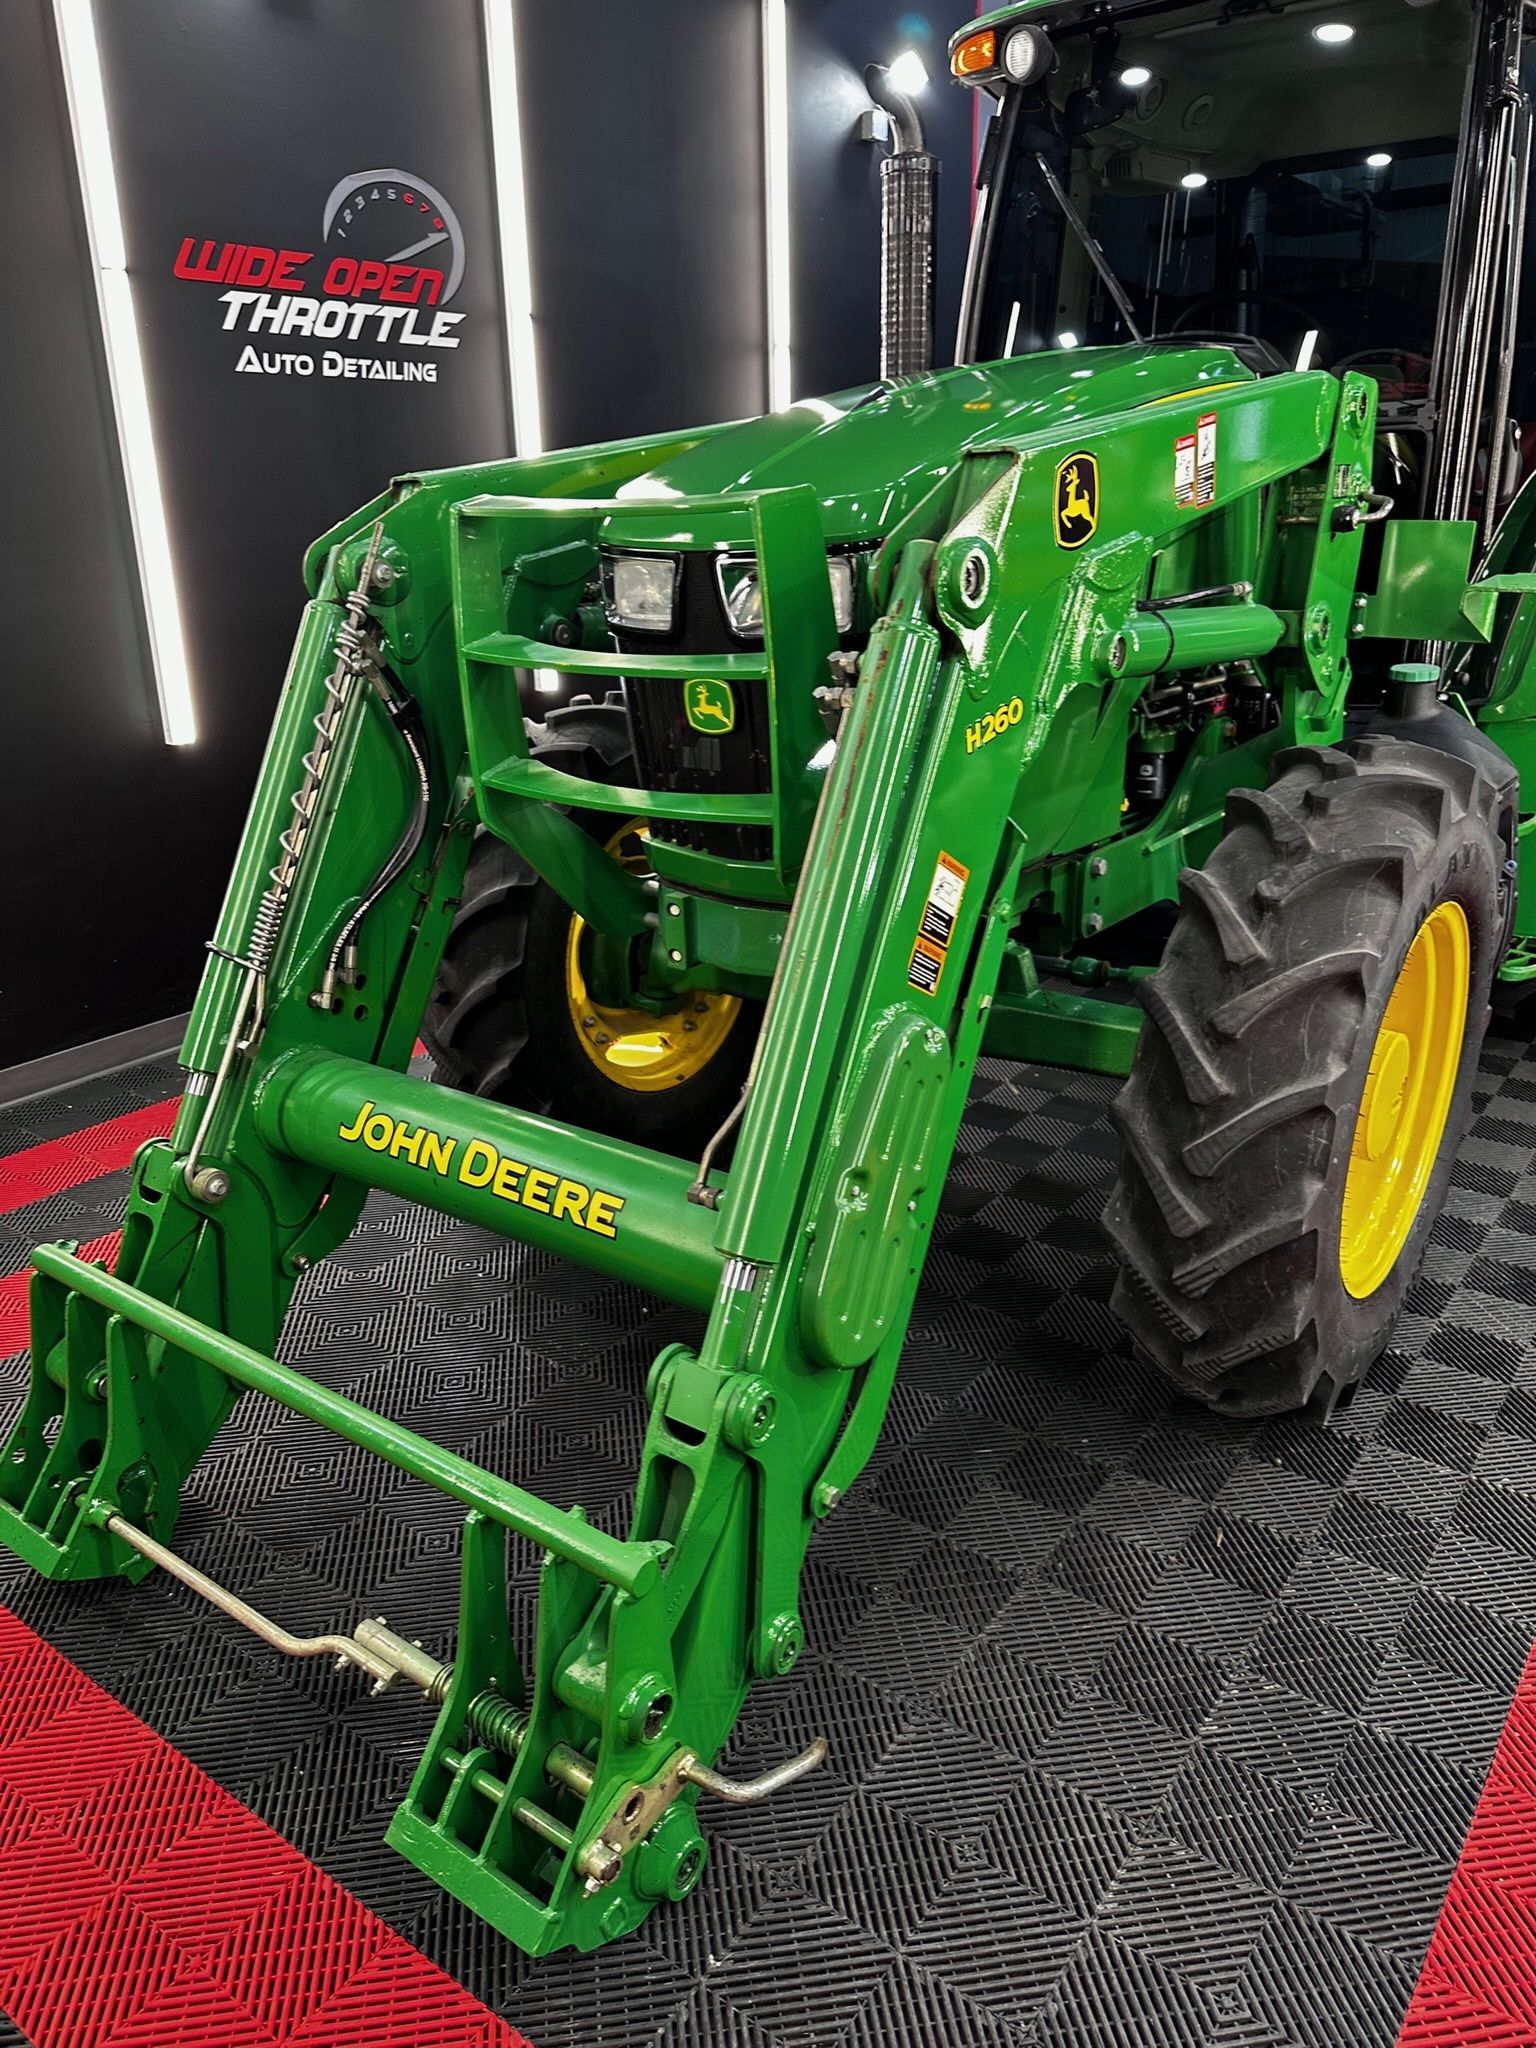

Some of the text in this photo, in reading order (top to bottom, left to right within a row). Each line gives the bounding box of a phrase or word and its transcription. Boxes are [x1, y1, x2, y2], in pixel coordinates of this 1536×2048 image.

[355, 195, 365, 210] 3
[370, 188, 380, 200] 4
[386, 188, 397, 200] 5
[402, 192, 415, 205] 6
[419, 202, 430, 213] 7
[173, 237, 444, 306] WIDE OPEN
[217, 289, 467, 349] THROTTLE
[966, 697, 1024, 754] H260
[338, 1101, 626, 1239] JOHN DEERE
